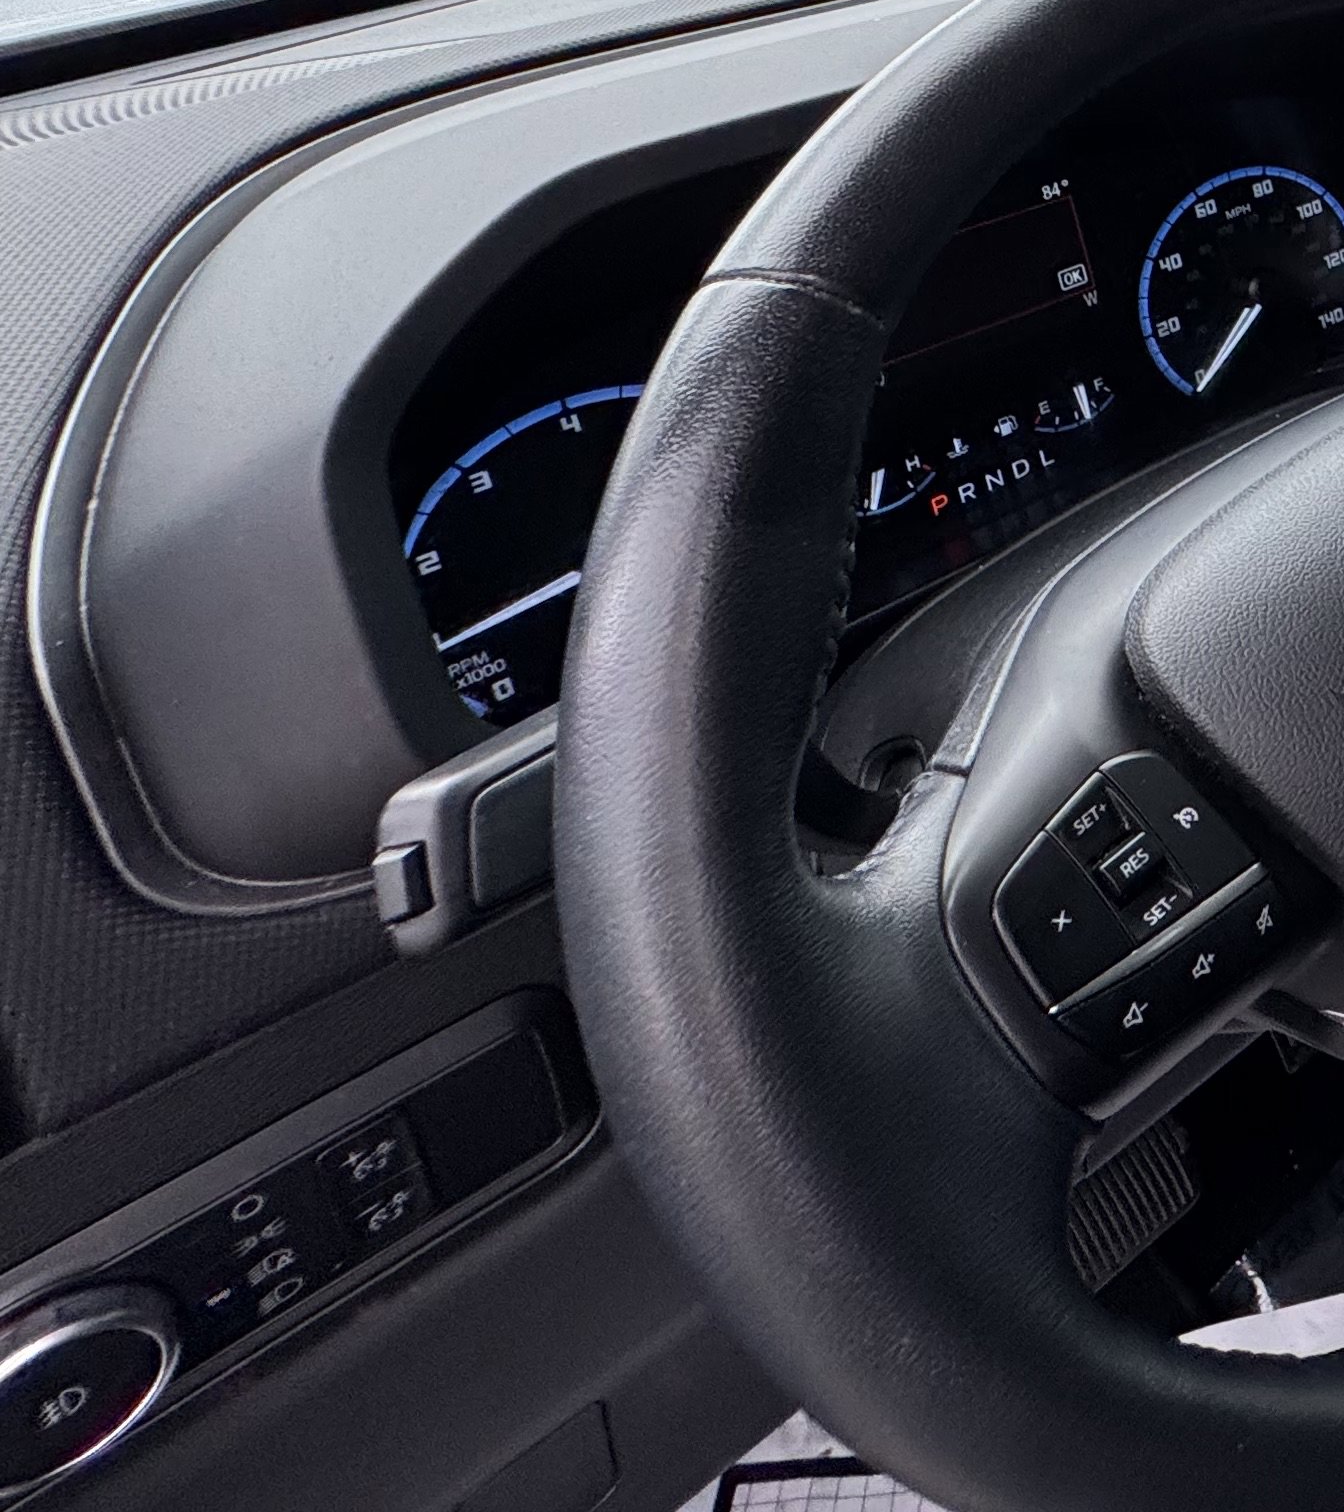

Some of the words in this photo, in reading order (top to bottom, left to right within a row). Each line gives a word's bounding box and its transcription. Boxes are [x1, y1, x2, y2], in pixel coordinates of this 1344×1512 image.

[1041, 179, 1069, 201] 84°
[1251, 178, 1274, 198] 80
[1194, 198, 1218, 219] 60
[1225, 202, 1252, 221] MPH
[1296, 198, 1323, 220] 100
[1158, 252, 1184, 273] 40
[1062, 268, 1084, 286] OK
[1083, 289, 1099, 307] W
[1156, 316, 1182, 338] 20
[1318, 306, 1344, 330] 140
[1093, 376, 1105, 392] F
[1038, 399, 1052, 416] E
[559, 413, 583, 433] 4
[905, 454, 922, 473] H
[468, 469, 494, 494] 3
[930, 493, 949, 517] P
[957, 481, 977, 504] R
[984, 468, 1005, 493] N
[1011, 458, 1031, 480] D
[1038, 449, 1056, 468] L
[415, 549, 442, 577] 2
[447, 649, 490, 679] RPM
[491, 676, 516, 702] 0
[1072, 803, 1107, 836] SET+
[1119, 848, 1150, 879] RES
[1143, 894, 1178, 927] SET-
